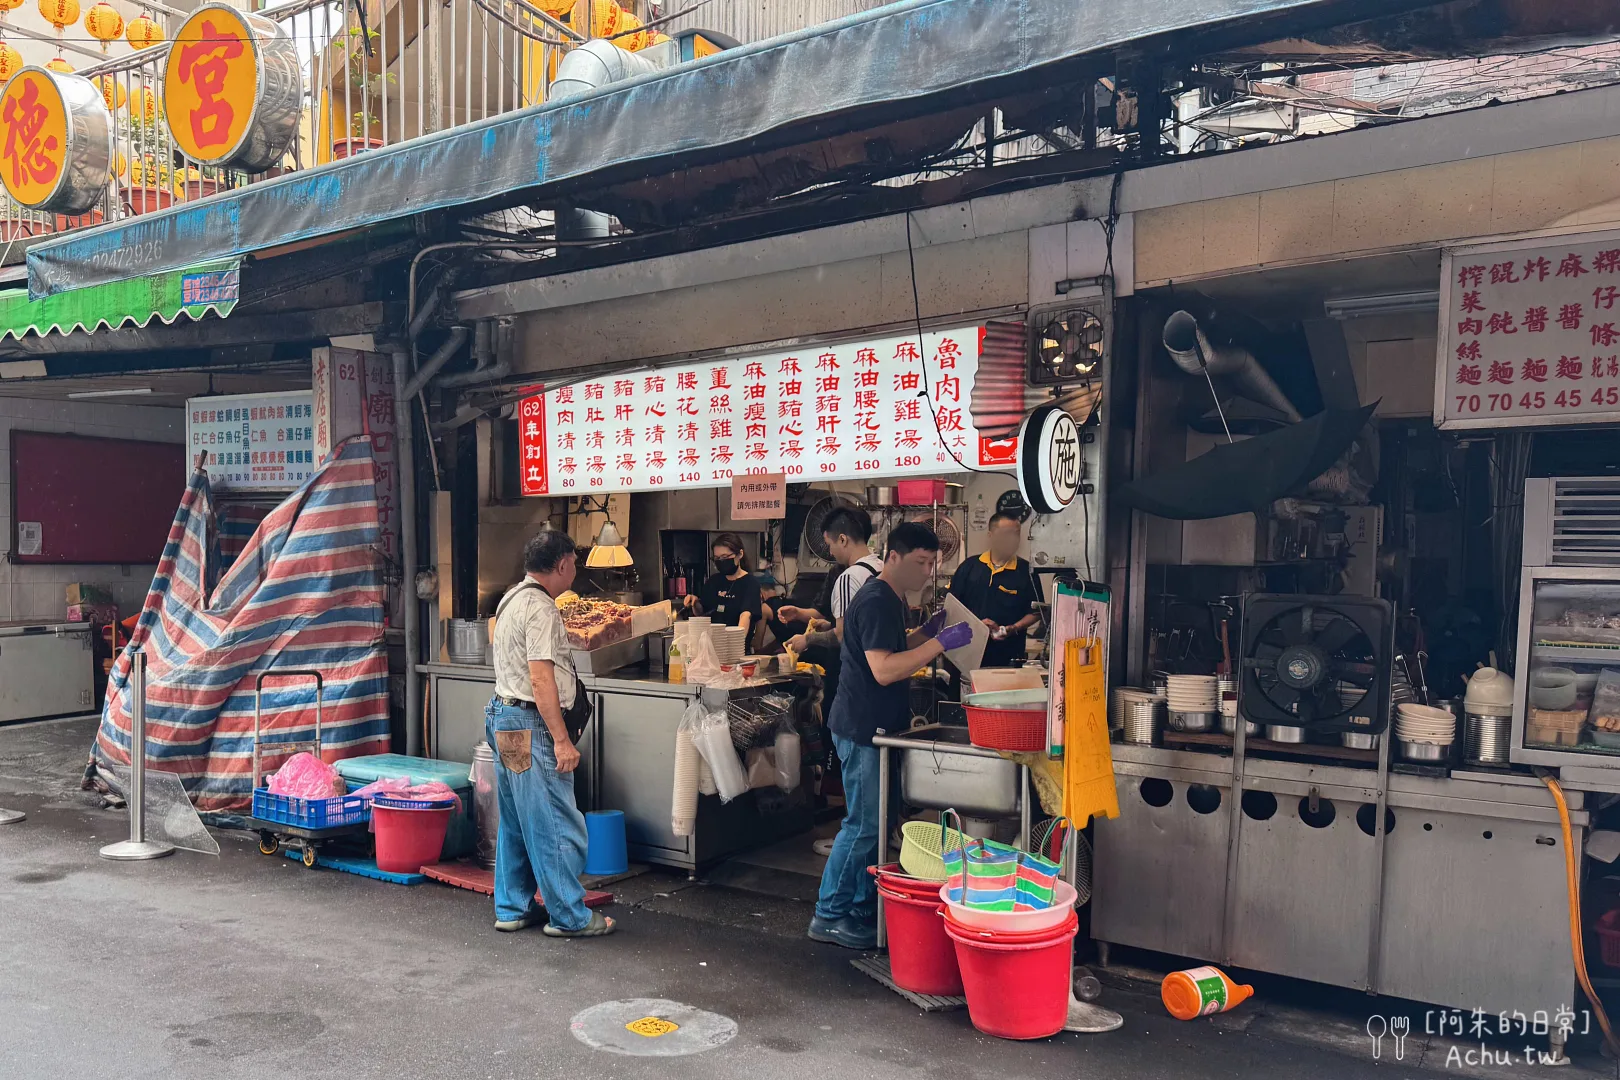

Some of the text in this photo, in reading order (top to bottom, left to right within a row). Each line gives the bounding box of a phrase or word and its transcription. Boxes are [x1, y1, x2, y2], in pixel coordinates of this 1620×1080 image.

[3, 78, 58, 189] 德
[178, 20, 244, 150] 宮
[339, 363, 395, 386] 62創立
[933, 337, 967, 432] 魯肉飯
[1455, 264, 1487, 413] 榨菜肉絲麵 70
[1485, 260, 1520, 412] 餛飩麵 70
[1519, 256, 1551, 410] 炸醬麵 45
[1554, 252, 1589, 408] 麻醬麵 45
[522, 401, 543, 482] 62年創立
[555, 386, 578, 488] 瘦肉清湯 80
[584, 382, 607, 486] 豬肚清湯 80
[613, 379, 637, 486] 豬肝清湯 70
[644, 375, 668, 485] 豬心清湯 80
[676, 371, 701, 482] 腰花清湯 140
[742, 361, 769, 475] 麻油瘦肉湯 100
[777, 357, 805, 475] 麻油豬心湯 100
[814, 352, 842, 473] 麻油豬肝湯 90
[852, 347, 882, 470] 麻油腰花湯 160
[892, 341, 923, 467] 麻油雞湯 180
[952, 434, 967, 447] 大
[1590, 386, 1618, 406] 45
[711, 469, 733, 480] 170
[737, 500, 781, 510] 請先排隊點餐
[740, 482, 777, 493] 內用或外帶
[936, 451, 946, 462] 40
